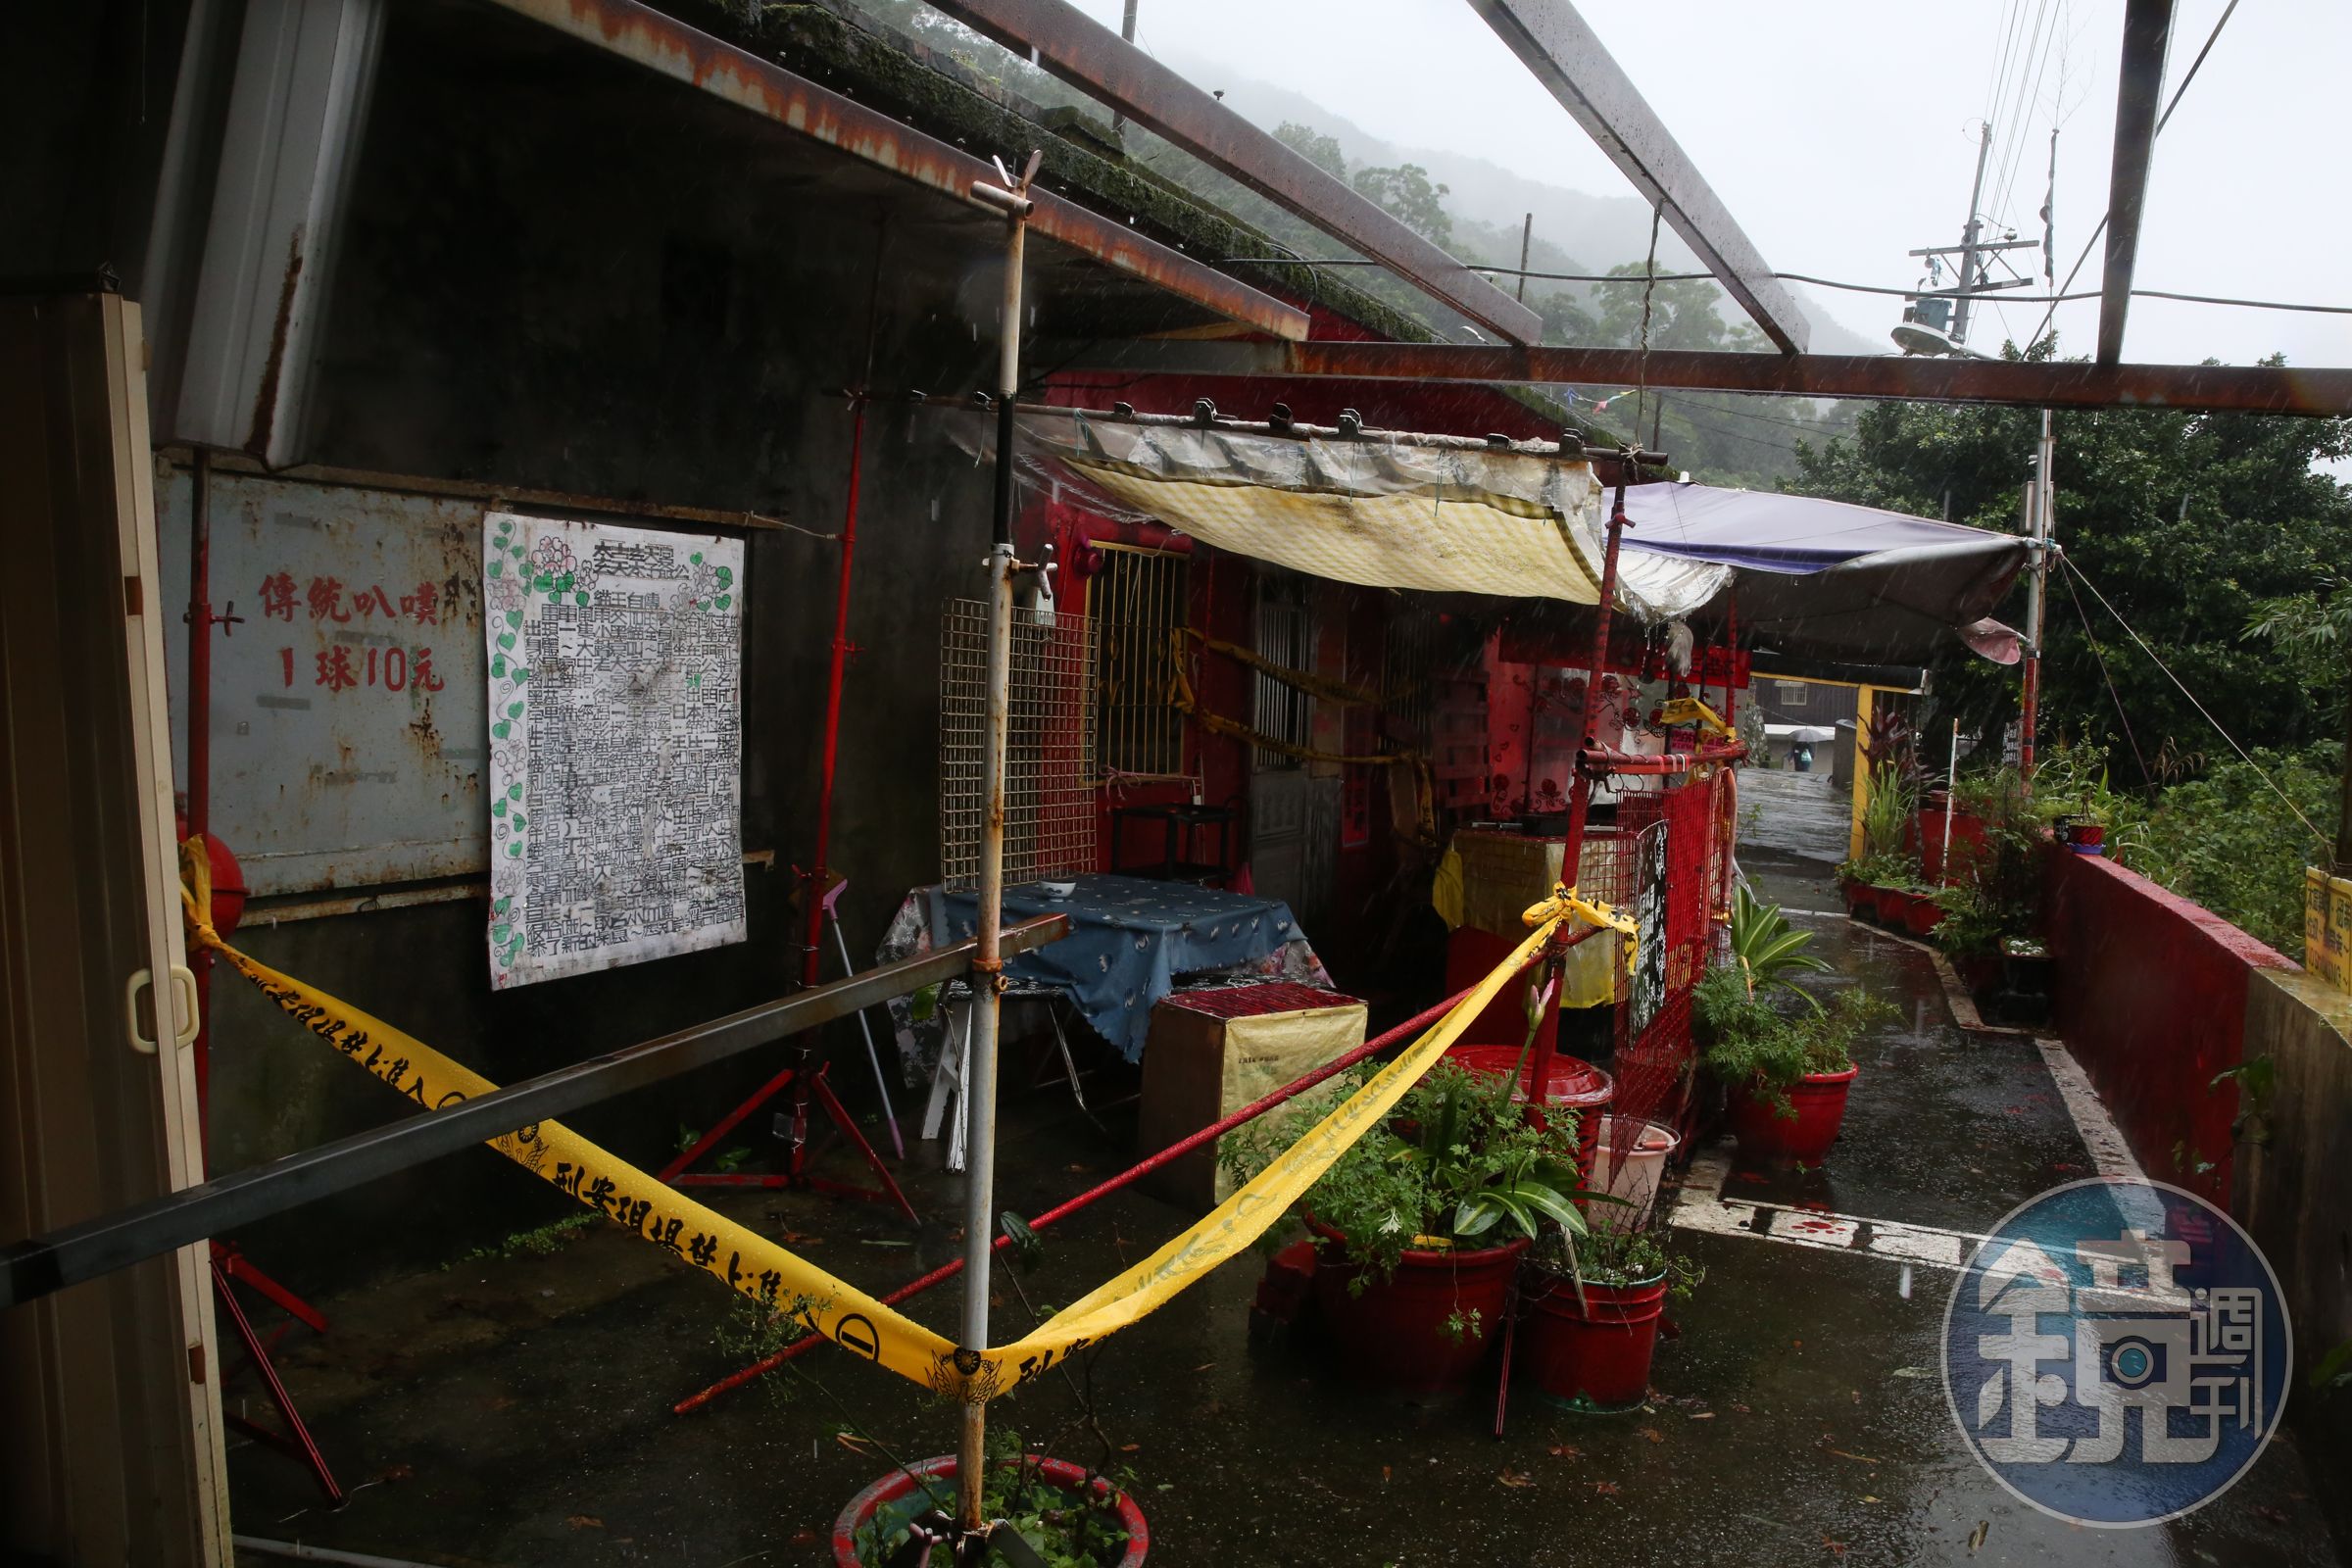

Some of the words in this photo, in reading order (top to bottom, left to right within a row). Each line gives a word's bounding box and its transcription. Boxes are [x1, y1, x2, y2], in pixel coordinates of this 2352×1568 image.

[259, 572, 439, 626] 傳統叭噗
[281, 645, 444, 694] 1球10元
